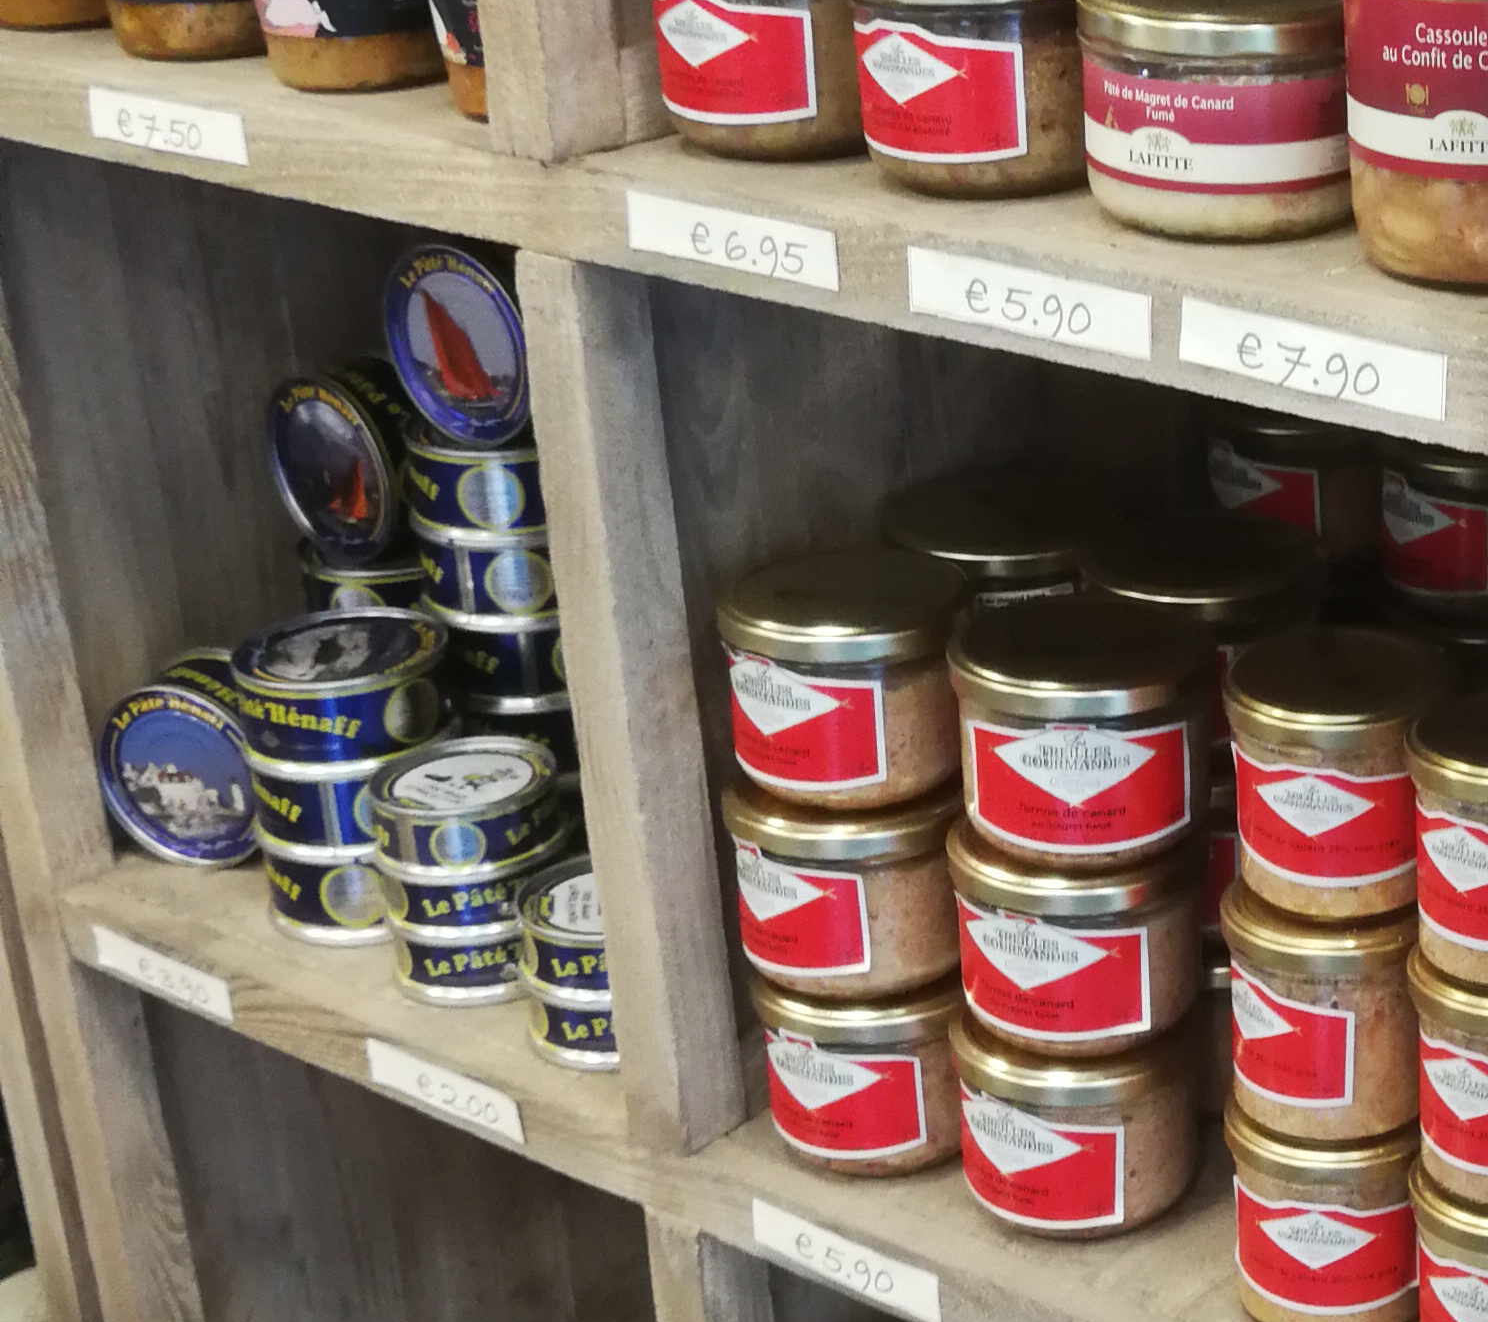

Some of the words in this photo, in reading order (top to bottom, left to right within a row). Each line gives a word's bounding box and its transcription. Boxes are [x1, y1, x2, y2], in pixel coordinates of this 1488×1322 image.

[1382, 45, 1397, 62] au
[1402, 45, 1447, 69] Confit
[1452, 49, 1472, 69] de
[1104, 80, 1120, 98] Pâté
[1122, 86, 1133, 100] de
[1135, 89, 1171, 107] Magret
[1174, 94, 1188, 109] de
[1191, 95, 1235, 111] Canard
[1146, 106, 1175, 123] Fumé
[1129, 149, 1193, 172] LAFITTE
[1020, 755, 1131, 770] GOURMANDES
[422, 898, 450, 918] Le
[453, 887, 506, 909] Pâté
[424, 957, 451, 977] Le
[453, 946, 506, 972] Pâté
